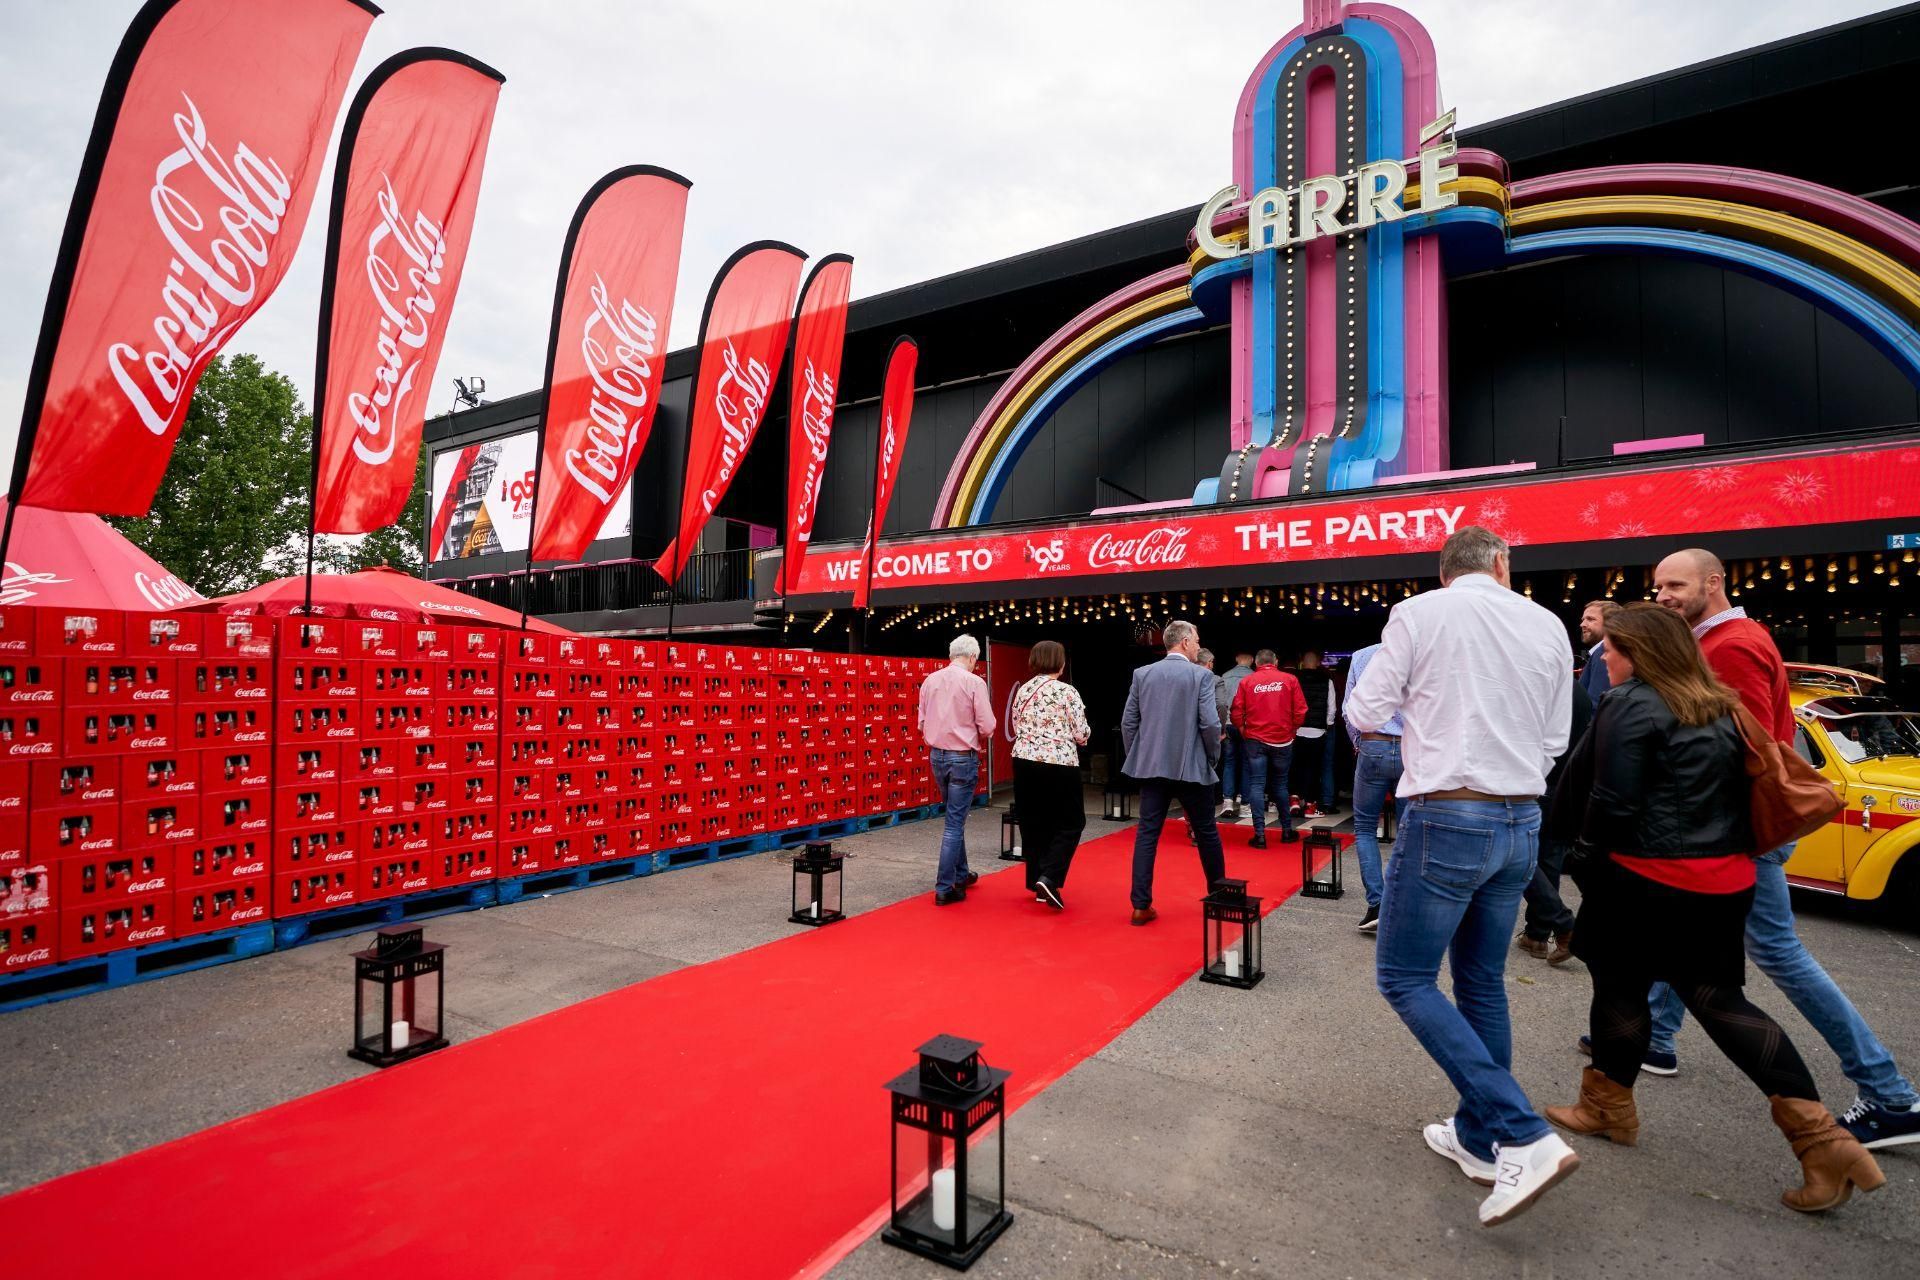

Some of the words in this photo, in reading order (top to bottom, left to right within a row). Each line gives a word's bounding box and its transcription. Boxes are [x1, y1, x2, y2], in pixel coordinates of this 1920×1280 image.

[1196, 107, 1458, 259] CARRÉ
[1235, 520, 1312, 551] THE
[1326, 506, 1466, 545] PARTY
[827, 551, 950, 582] WECOME
[956, 548, 993, 572] TO
[1035, 540, 1065, 572] 95
[1088, 527, 1192, 569] Coca-Cola
[1048, 563, 1071, 572] YEARS
[1498, 1162, 1524, 1187] N
